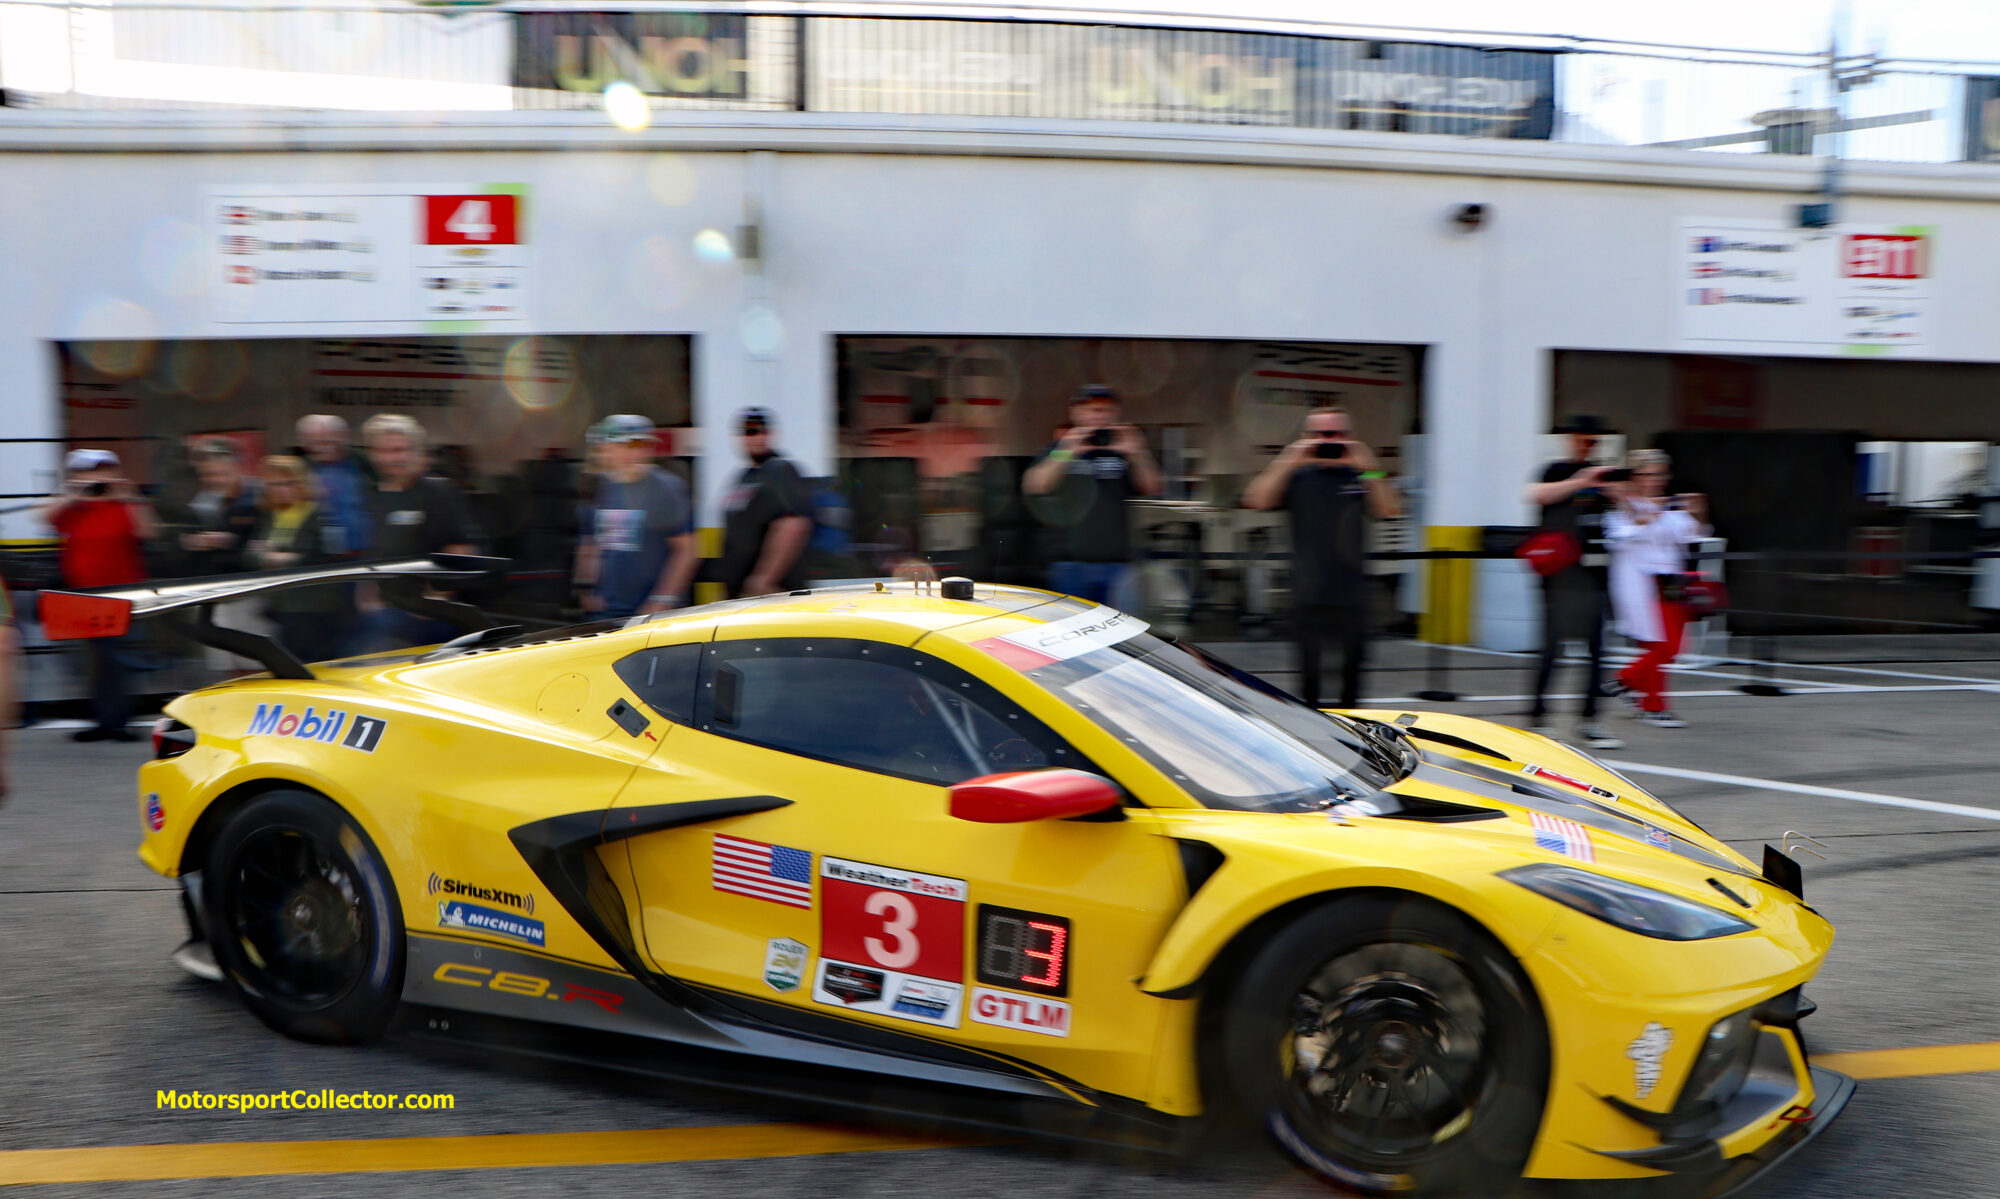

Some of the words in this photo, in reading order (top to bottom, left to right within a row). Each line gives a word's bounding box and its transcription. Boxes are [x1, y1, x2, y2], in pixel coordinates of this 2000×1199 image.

[443, 199, 498, 241] 4
[246, 703, 347, 744] Mobil
[826, 861, 961, 898] WeatherTech
[467, 912, 544, 941] MICHELIN
[863, 890, 921, 969] 3
[1020, 920, 1068, 988] 3
[433, 962, 625, 1015] C8.R
[976, 993, 1067, 1034] GTLM
